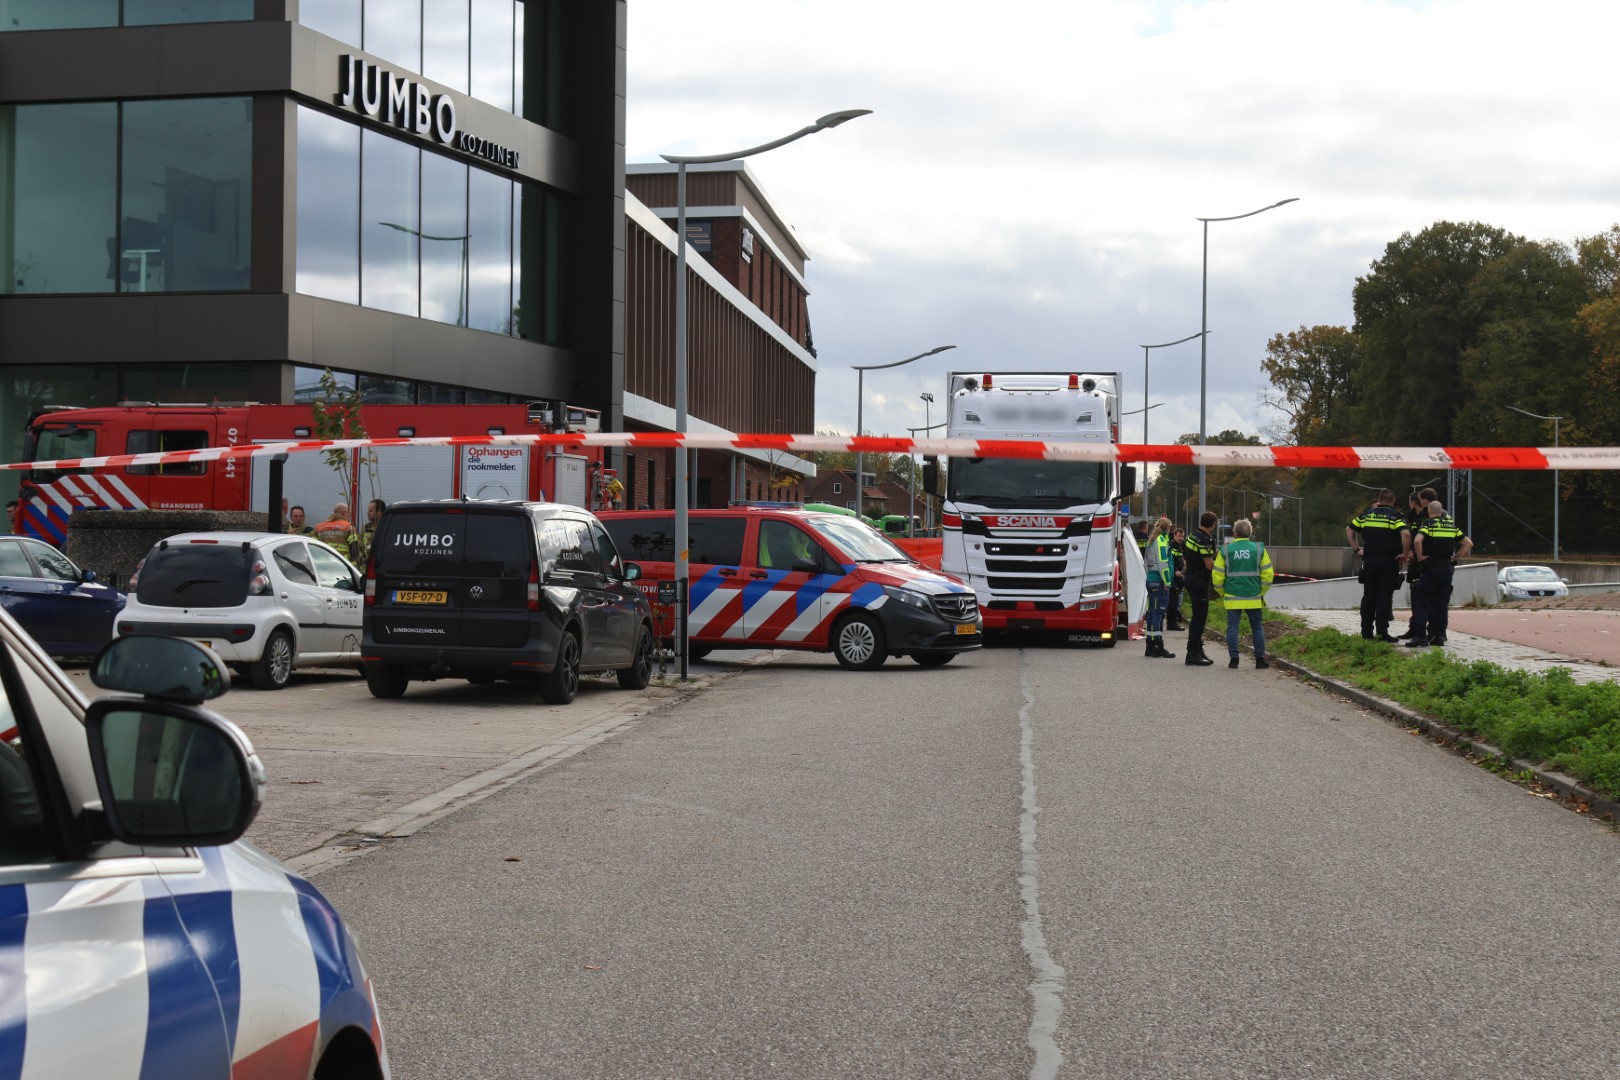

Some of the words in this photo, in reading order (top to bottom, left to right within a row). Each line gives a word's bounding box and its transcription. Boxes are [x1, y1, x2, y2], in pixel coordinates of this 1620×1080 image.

[339, 54, 457, 144] JUMBO
[459, 131, 520, 169] KOZIJNEN
[468, 446, 523, 458] Ophangen
[467, 462, 517, 471] rookmelder.
[997, 516, 1057, 528] SCANIA
[394, 533, 454, 547] JUMBO
[1233, 549, 1251, 560] ARS
[400, 591, 443, 602] VSF-07-D
[336, 599, 358, 609] JUMBO
